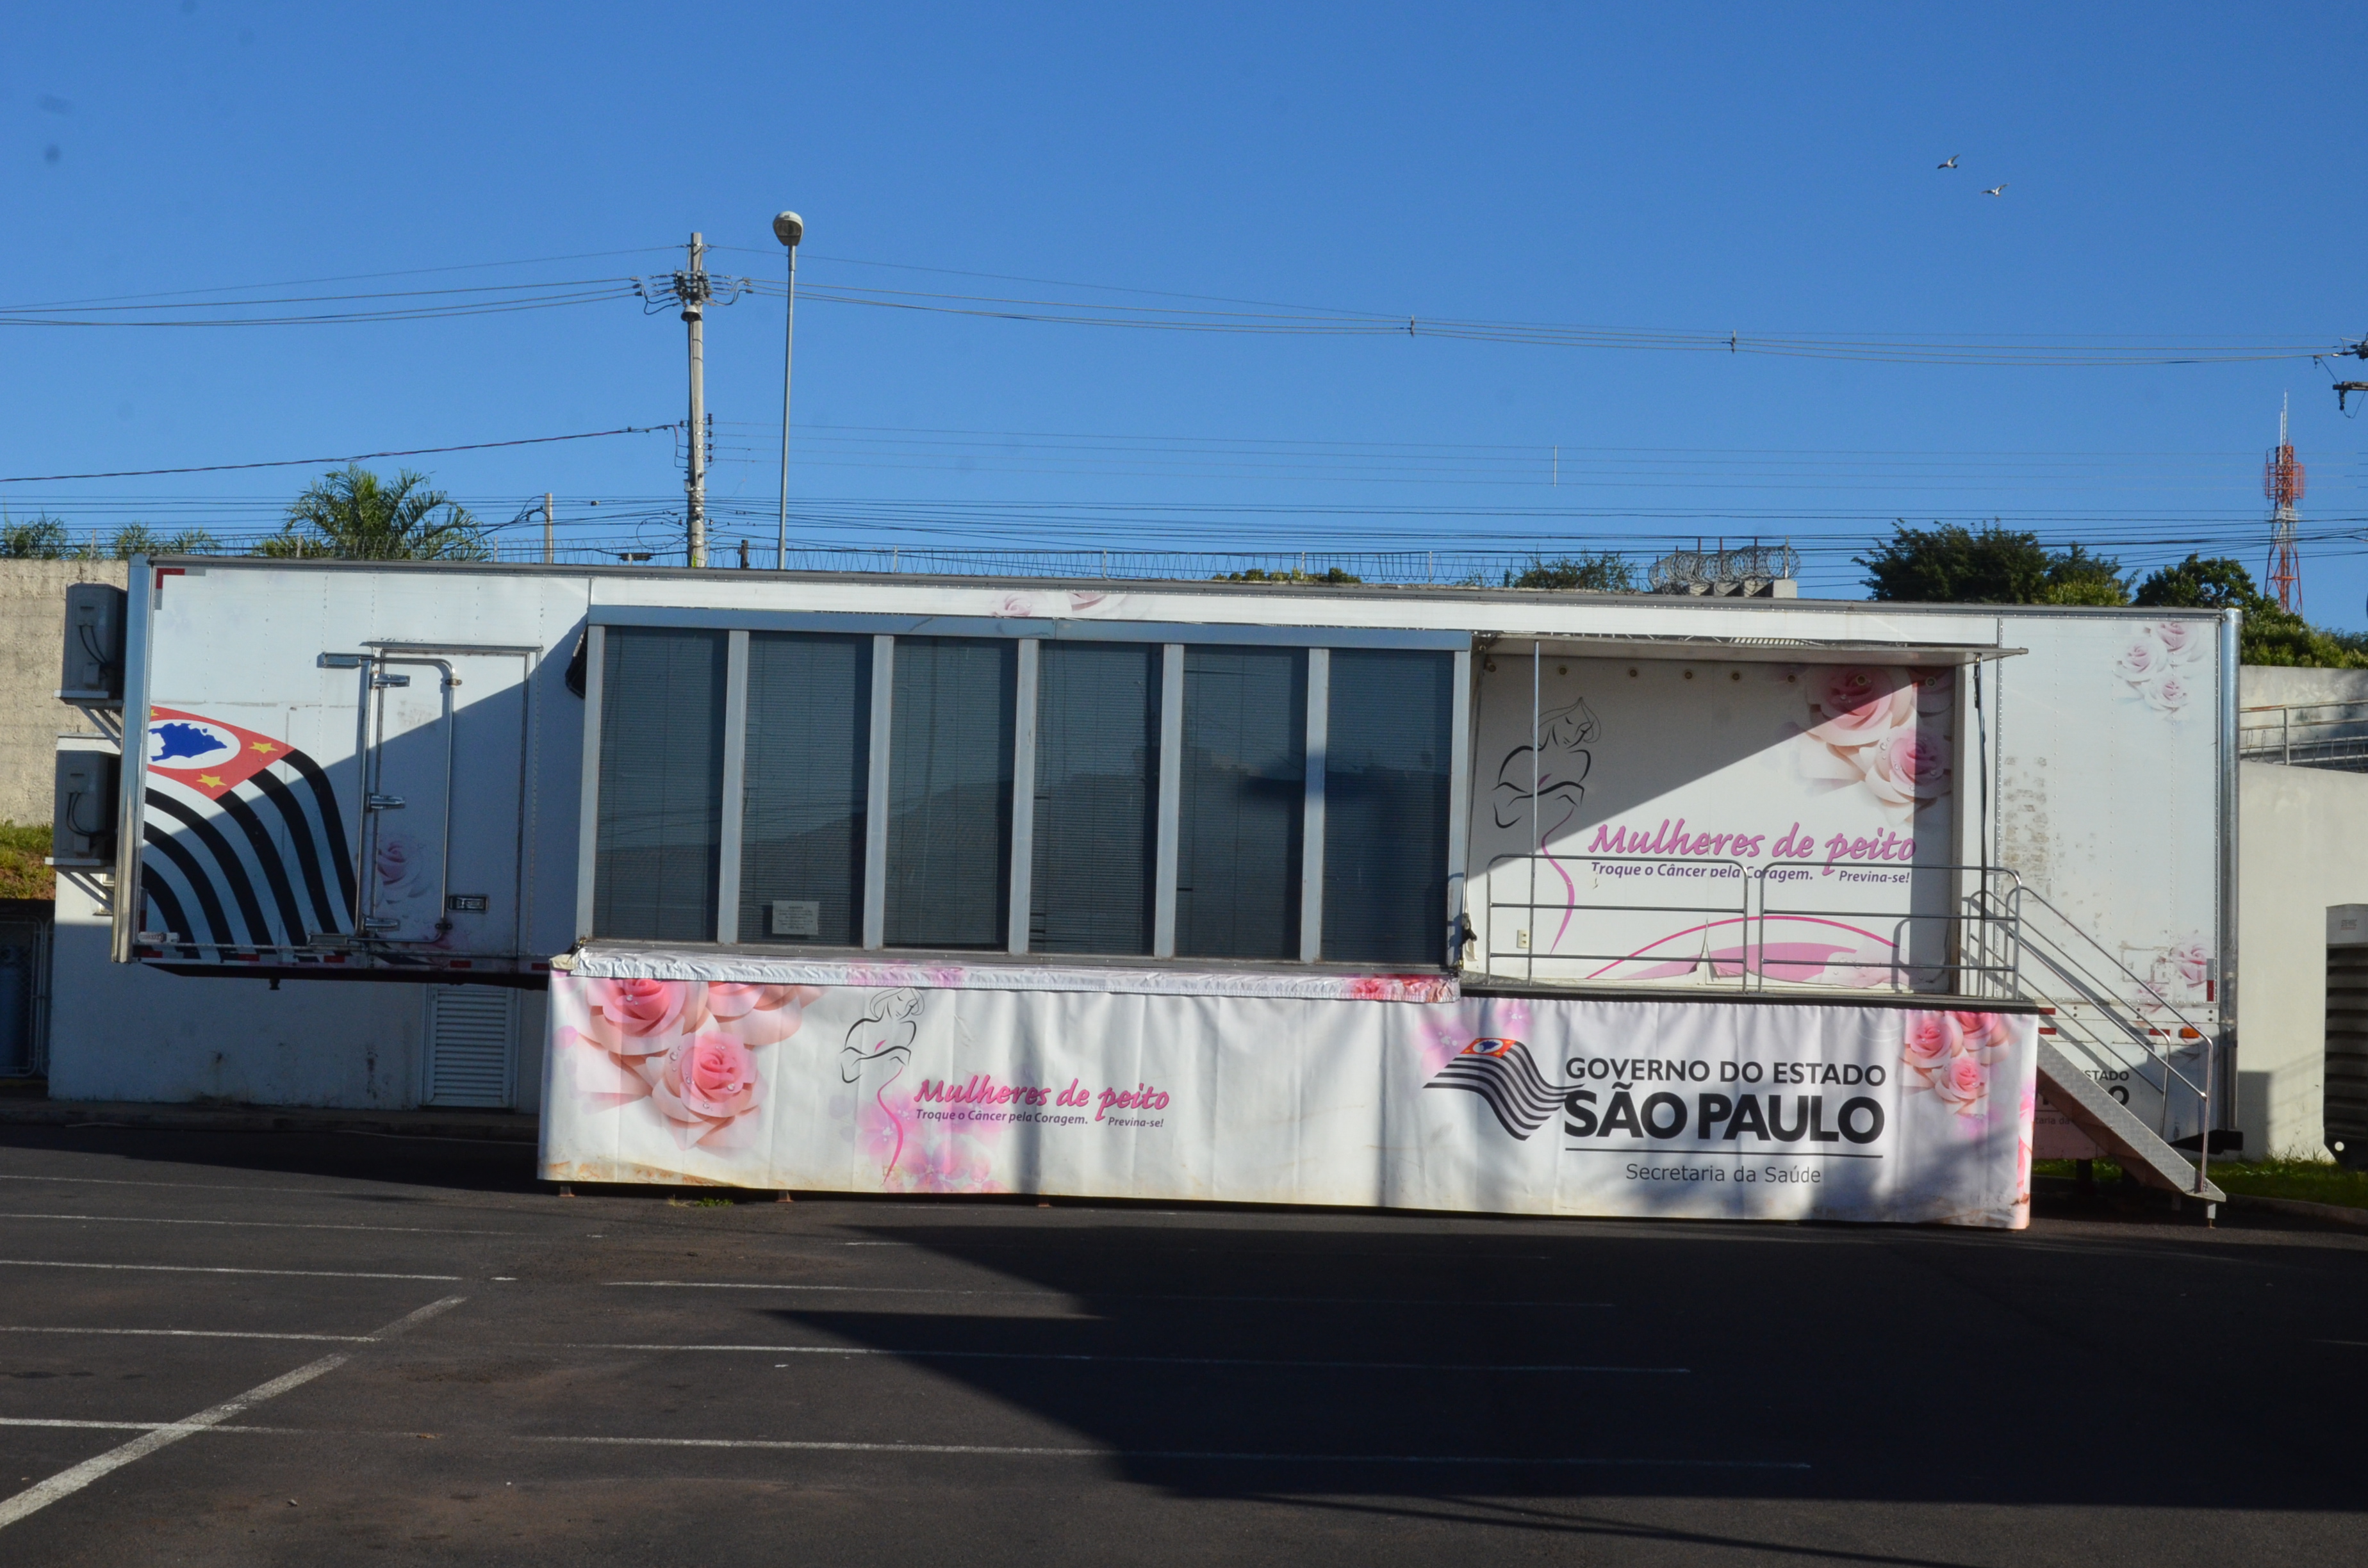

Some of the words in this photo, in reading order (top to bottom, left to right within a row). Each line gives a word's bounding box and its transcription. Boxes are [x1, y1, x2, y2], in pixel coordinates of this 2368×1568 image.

[1588, 818, 1765, 857] Mulheres
[1772, 822, 1814, 858] de
[1821, 827, 1916, 876] peito
[1591, 862, 1641, 878] Troque
[1645, 867, 1653, 876] o
[1657, 863, 1707, 878] Câncer
[1710, 865, 1740, 878] pela
[1839, 870, 1910, 883] Previna-se!
[1566, 1057, 1710, 1082] GOVERNO
[1720, 1061, 1763, 1084] DO
[1773, 1062, 1886, 1086] ESTADO
[2081, 1070, 2130, 1081] STADO
[914, 1075, 1051, 1106] Mulheres
[1056, 1078, 1090, 1107] de
[1094, 1082, 1169, 1122] peito
[916, 1109, 957, 1122] Troque
[958, 1112, 965, 1120] o
[968, 1109, 1007, 1122] Câncer
[1008, 1112, 1032, 1124] pela
[1034, 1112, 1089, 1126] Coragem.
[1108, 1116, 1164, 1127] Previna-se!
[1564, 1081, 1688, 1139] SÃO
[1697, 1093, 1885, 1145] PAULO
[1625, 1163, 1725, 1182] Secretaria
[1732, 1165, 1757, 1183] da
[1764, 1164, 1821, 1184] Saúde
